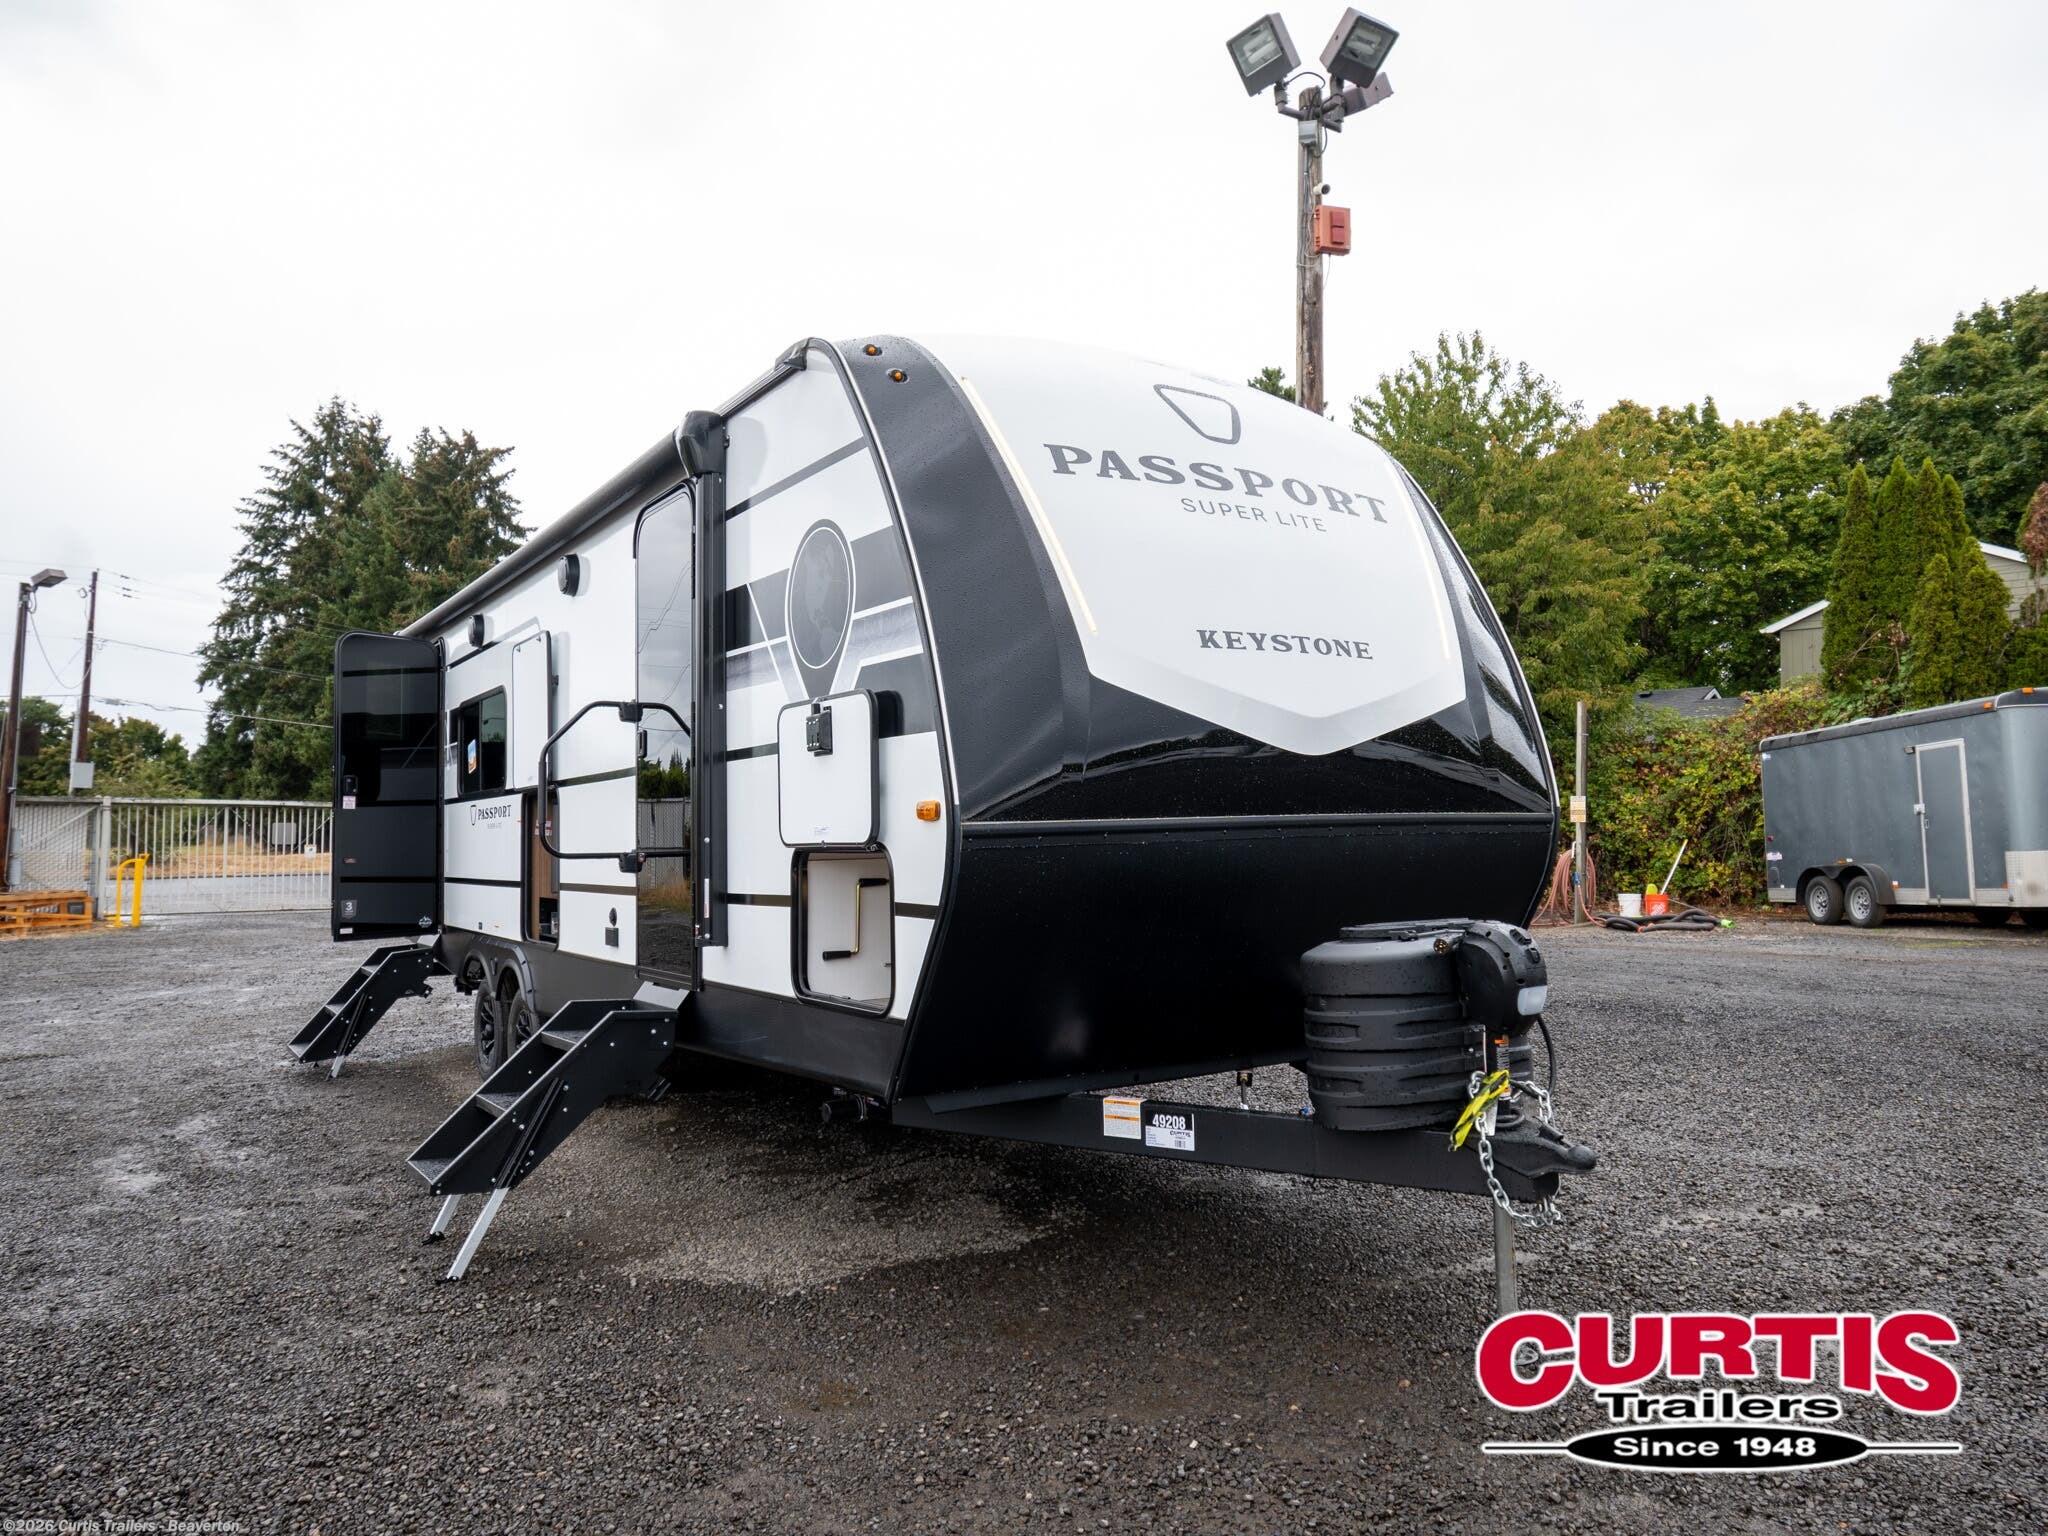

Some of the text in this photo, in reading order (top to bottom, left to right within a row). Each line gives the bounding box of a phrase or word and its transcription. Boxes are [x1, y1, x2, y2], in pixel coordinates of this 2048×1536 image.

[1043, 443, 1388, 524] PASSPORT
[1180, 497, 1328, 532] SUPER LITE
[1196, 629, 1374, 660] KEYSTONE
[477, 804, 512, 820] PASSPORT
[345, 901, 353, 911] 3
[1152, 1114, 1186, 1130] 49208
